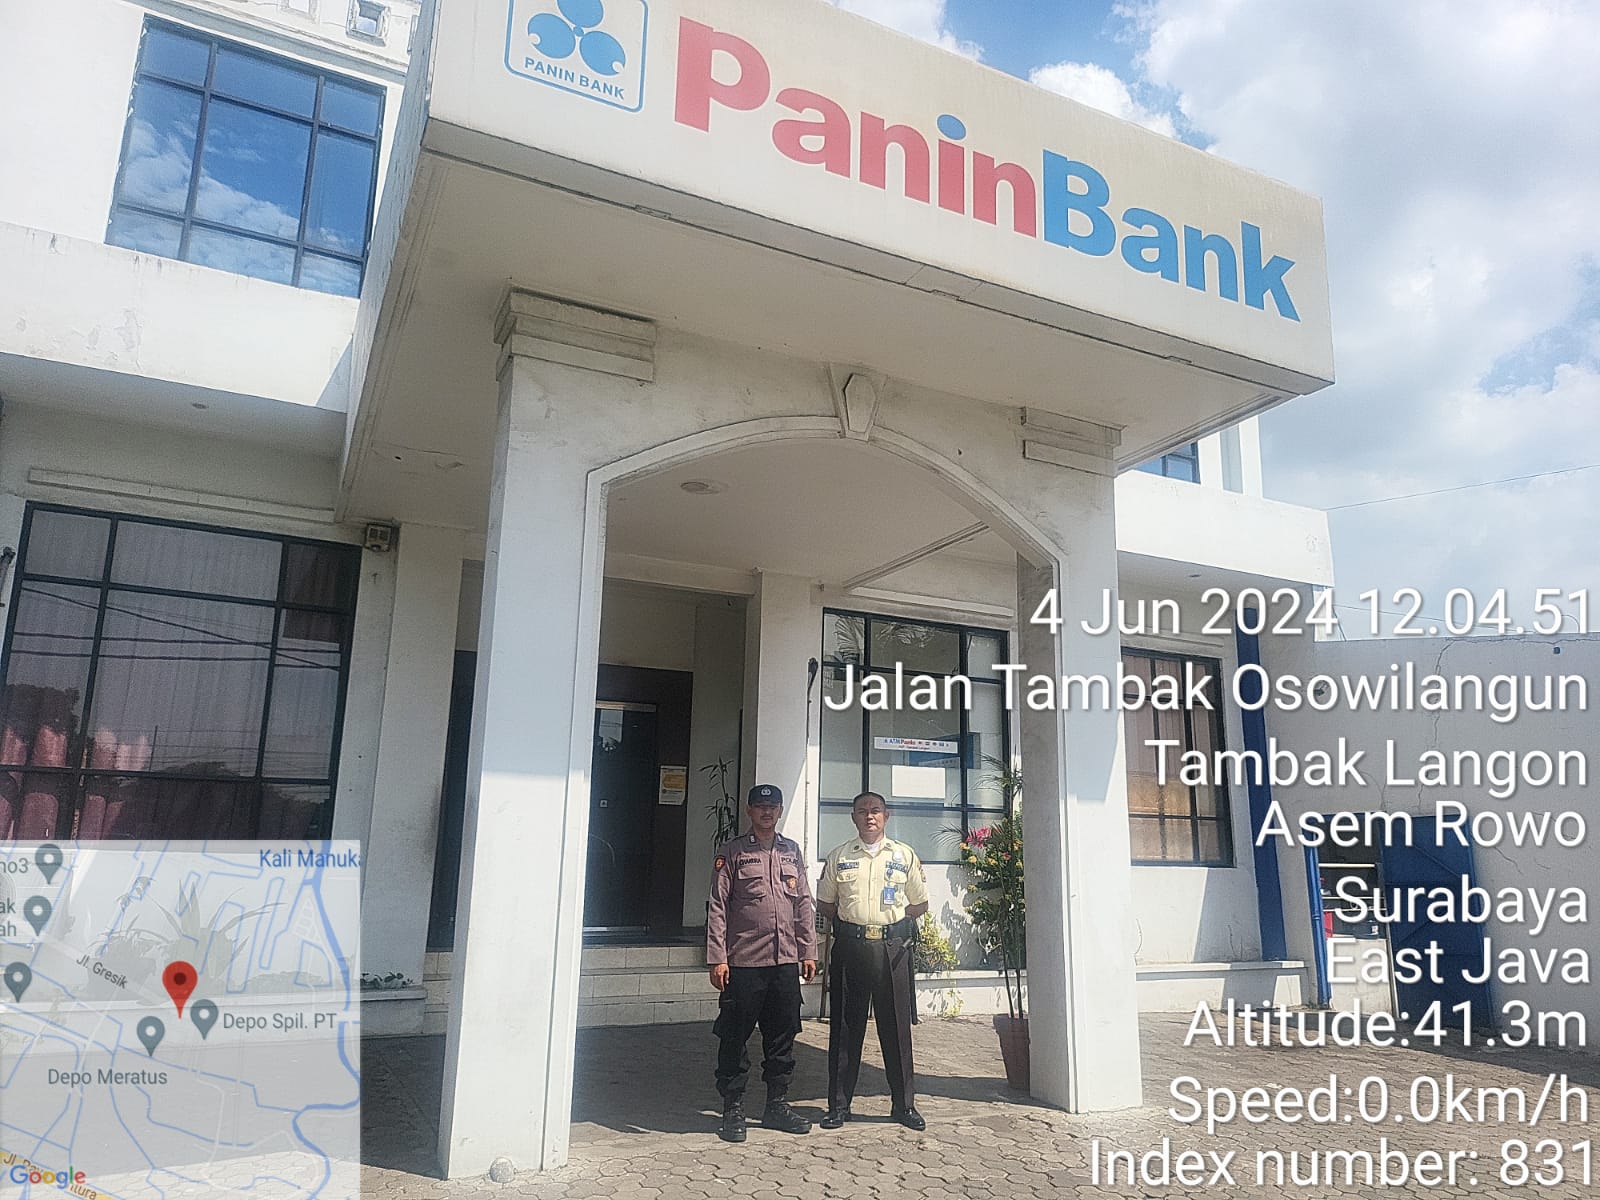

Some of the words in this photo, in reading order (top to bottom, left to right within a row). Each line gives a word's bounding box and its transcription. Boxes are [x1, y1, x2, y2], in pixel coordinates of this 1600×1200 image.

[524, 57, 575, 83] PANIN
[579, 75, 625, 100] BANK
[674, 16, 1300, 323] PaninBank
